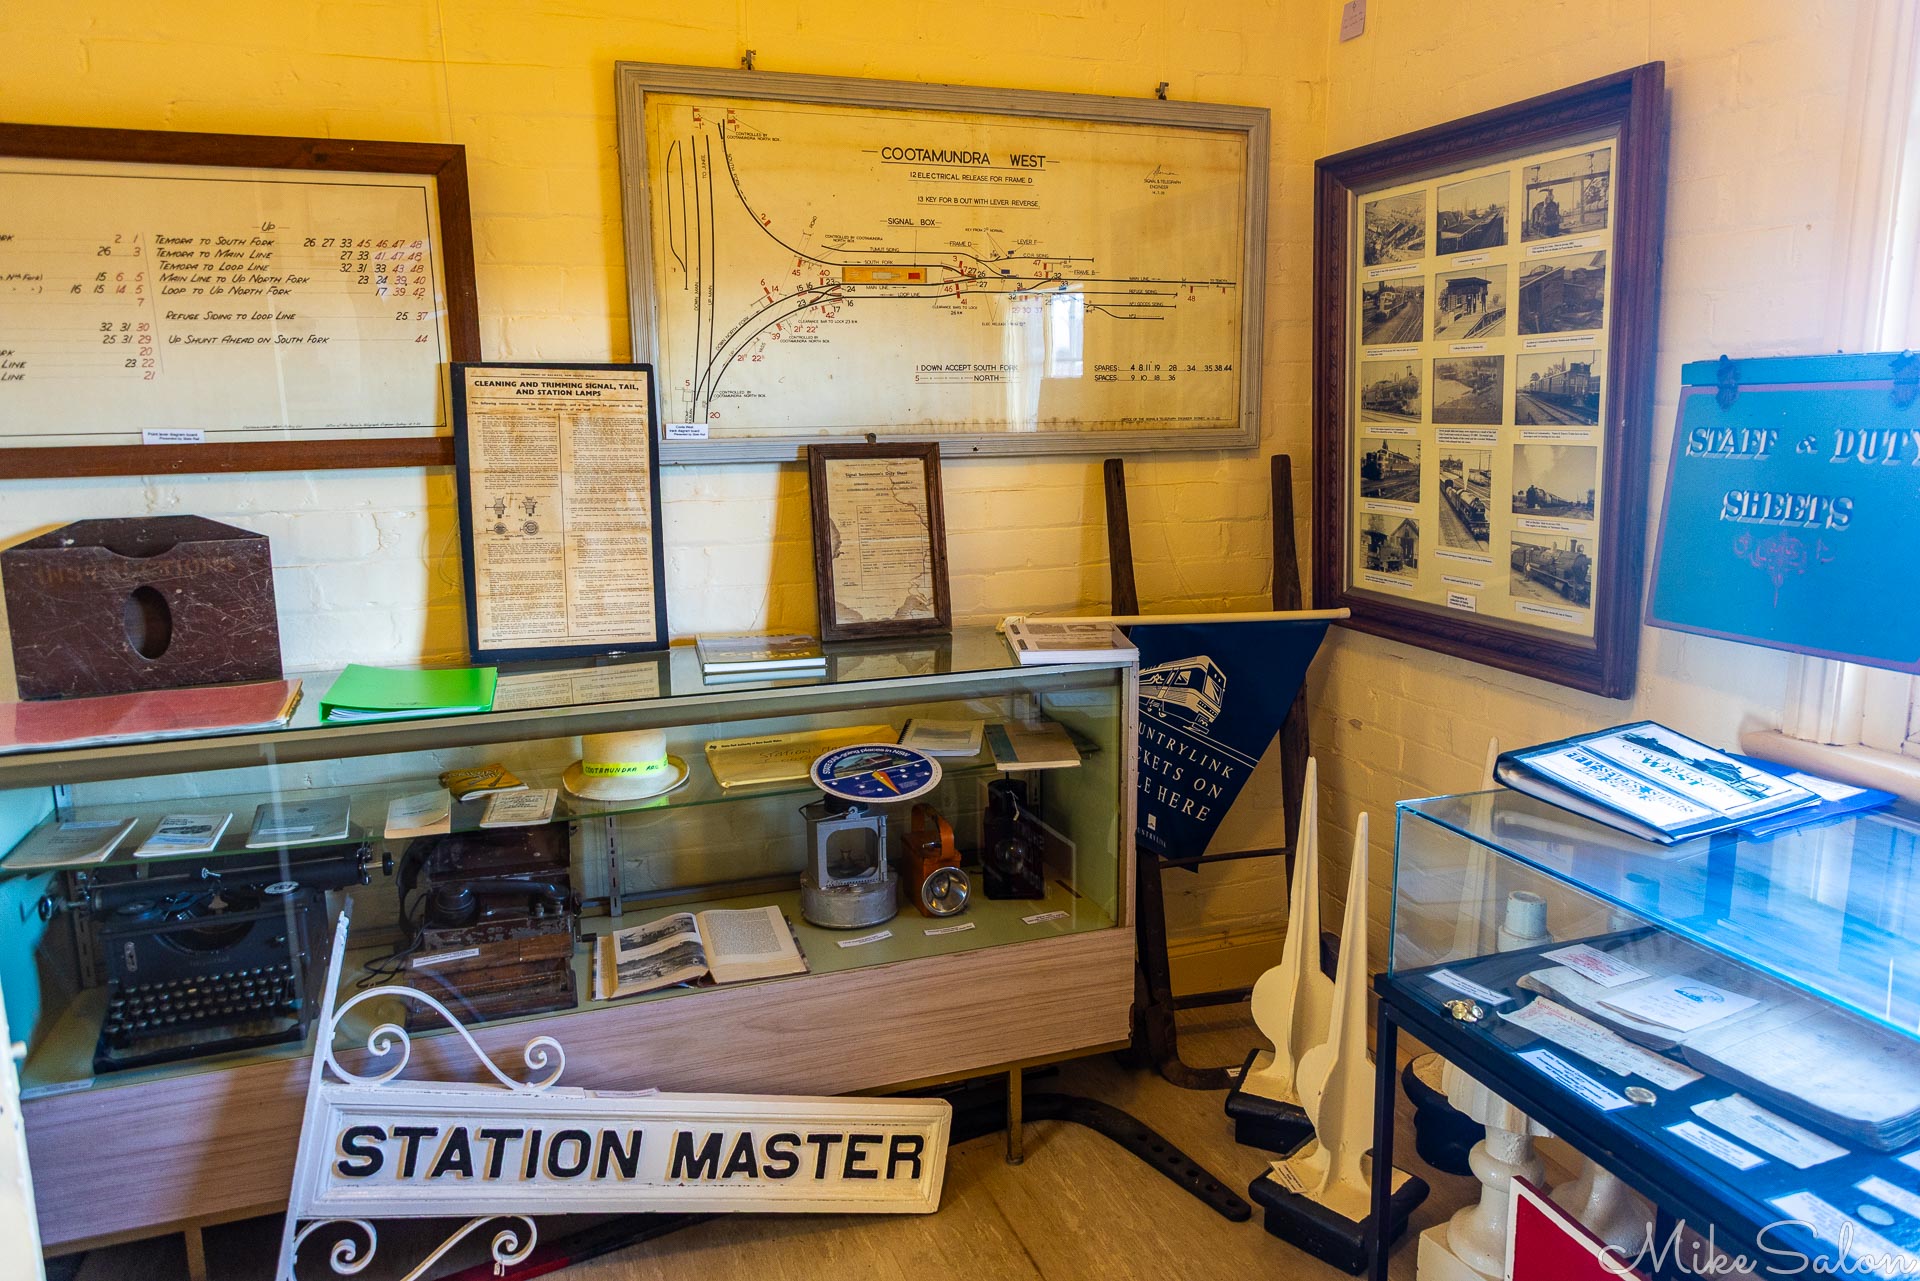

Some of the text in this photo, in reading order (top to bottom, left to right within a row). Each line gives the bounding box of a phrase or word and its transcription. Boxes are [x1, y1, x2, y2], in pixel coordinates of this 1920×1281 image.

[881, 147, 1046, 167] COOTAMUNDRA WEST
[917, 172, 959, 180] ELECTRICAL
[962, 174, 988, 182] RELEASE
[155, 234, 193, 245] TEMORA
[215, 236, 246, 246] SOUTH
[250, 238, 275, 246] FORK
[304, 238, 316, 247] 26
[322, 238, 335, 247] 27
[340, 239, 352, 248] 33
[357, 240, 371, 248] 45
[376, 240, 388, 248] 46
[392, 240, 405, 248] 47
[410, 240, 422, 249] 48
[156, 248, 194, 257] TEMORA
[214, 249, 244, 258] MAIN
[249, 250, 273, 259] LINE
[340, 251, 353, 260] 27
[357, 251, 369, 260] 33
[374, 252, 385, 260] 41
[390, 252, 404, 260] 47
[408, 252, 422, 261] 48
[160, 260, 199, 270] TEMORA
[219, 261, 244, 271] LOOP
[248, 262, 270, 271] LINE
[340, 263, 352, 273] 32
[357, 263, 367, 273] 31
[374, 264, 386, 273] 33
[392, 264, 404, 273] 43
[410, 264, 424, 273] 48
[160, 273, 188, 282] MAIN
[190, 274, 212, 283] LINE
[232, 274, 246, 283] UP
[248, 274, 282, 284] NORTH
[285, 274, 310, 284] FORK
[358, 276, 369, 284] 23
[376, 276, 388, 284] 24
[394, 276, 406, 285] 39
[413, 276, 426, 285] 40
[162, 285, 186, 294] LOOP
[210, 286, 224, 295] UP
[228, 286, 263, 295] NORTH
[266, 286, 292, 295] FORK
[375, 288, 387, 296] 17
[393, 288, 406, 296] 39
[413, 288, 426, 297] 42
[166, 310, 199, 320] REFUGE
[203, 310, 233, 320] SIDING
[251, 311, 273, 320] LOOP
[275, 311, 296, 320] LINE
[396, 312, 408, 320] 25
[416, 312, 428, 320] 37
[100, 323, 150, 332] 32 31 30
[103, 335, 151, 344] 25 31 29
[168, 335, 182, 344] UP
[184, 335, 218, 344] SHUNT
[220, 335, 254, 344] AHEAD
[274, 335, 303, 344] SOUTH
[307, 334, 330, 344] FORK
[415, 335, 428, 343] 44
[139, 347, 152, 356] 20
[1, 359, 155, 368] LINE 23 22
[144, 371, 155, 380] 21
[1686, 427, 1779, 460] STAFF
[1795, 434, 1818, 455] &
[1720, 490, 1855, 531] SHEETS
[1138, 721, 1234, 779] UNTRYLINK
[1194, 778, 1223, 799] ON
[1158, 785, 1211, 821] HERE
[336, 1125, 924, 1180] STATION MASTER
